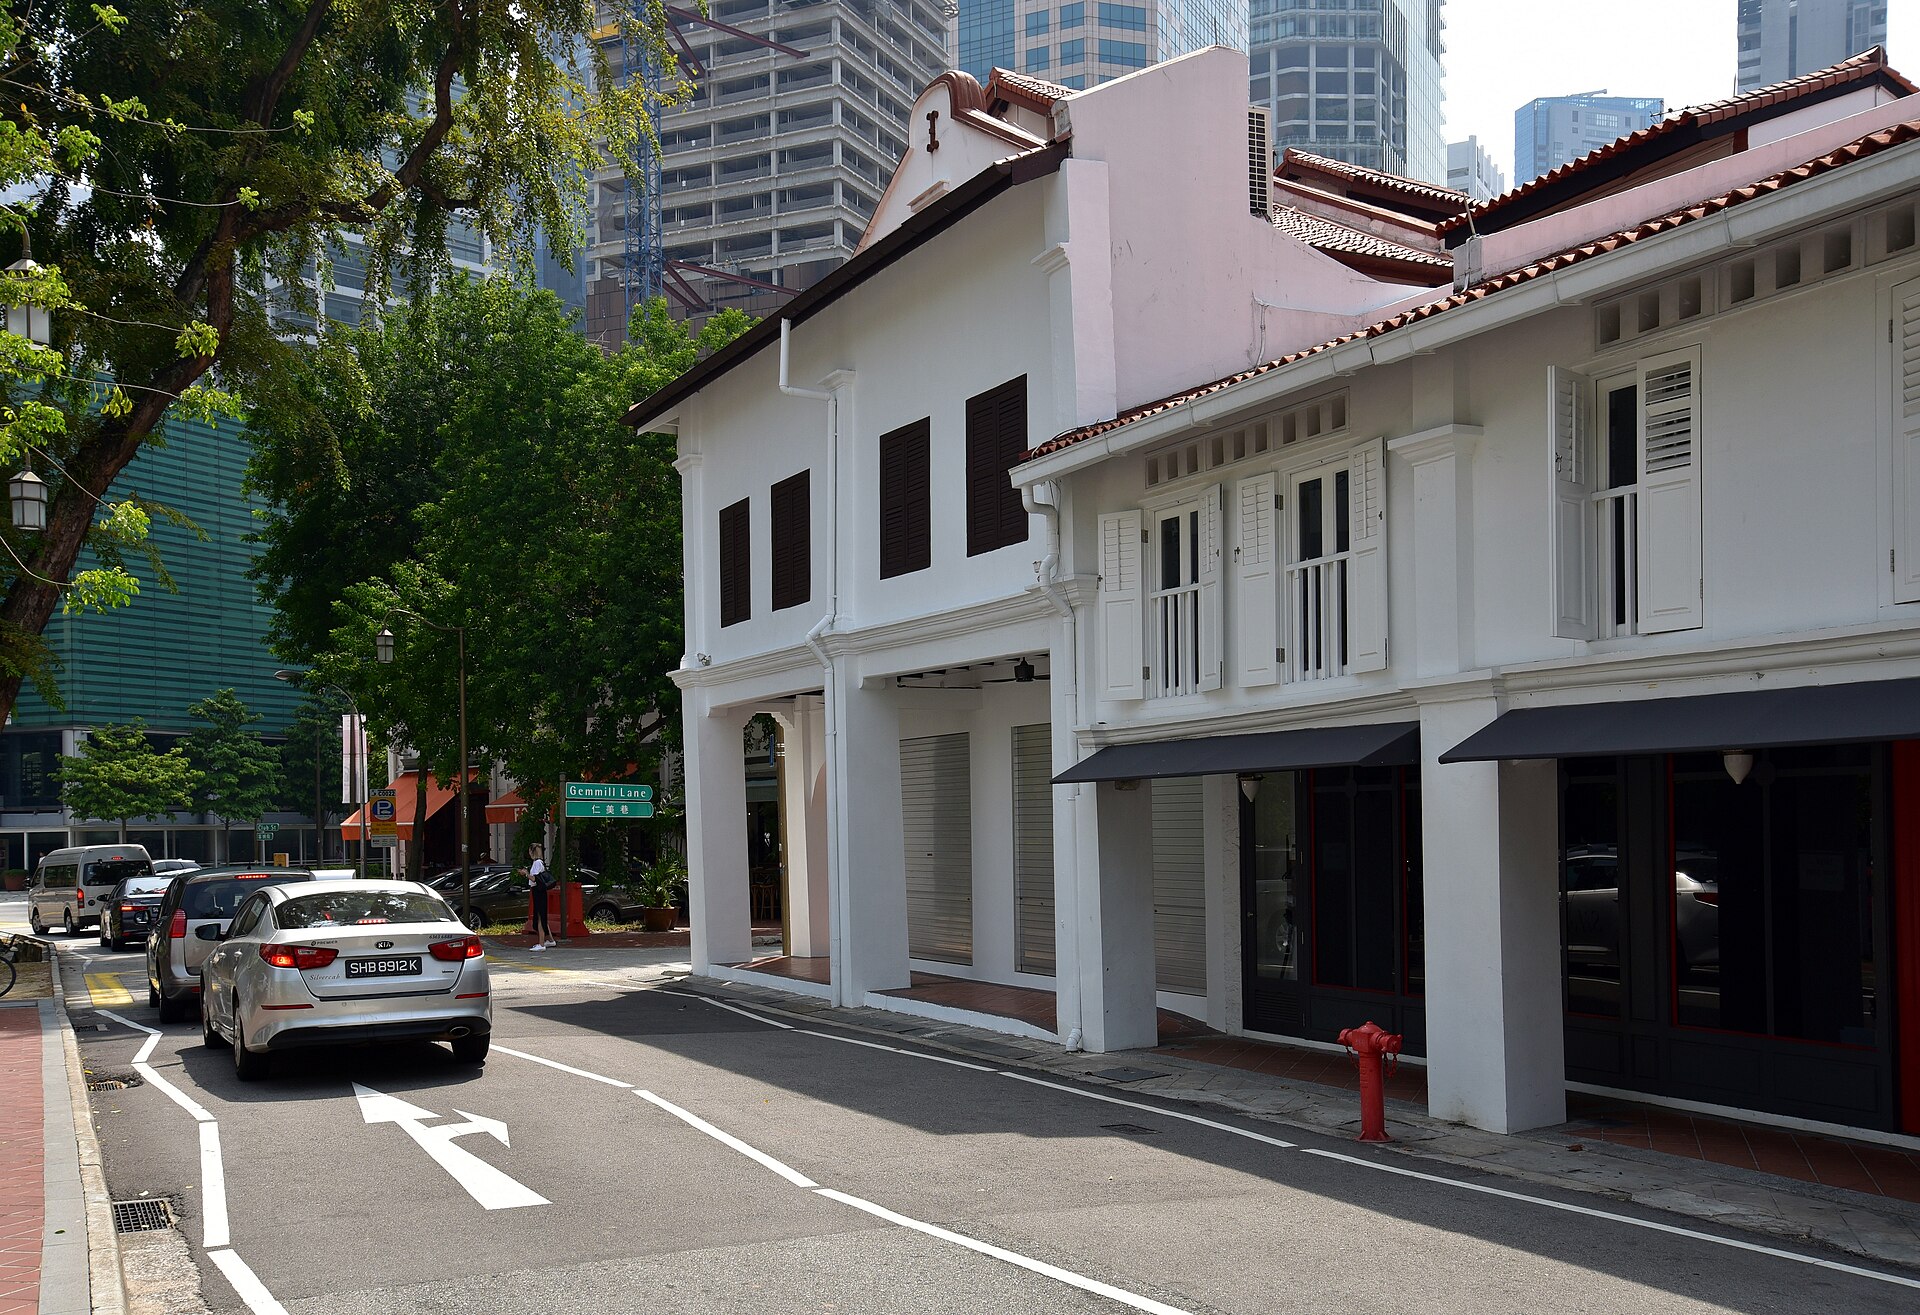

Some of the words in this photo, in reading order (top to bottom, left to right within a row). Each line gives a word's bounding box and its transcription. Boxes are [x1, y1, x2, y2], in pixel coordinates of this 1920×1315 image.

[569, 785, 616, 797] Gemmill
[620, 787, 646, 798] Lane
[378, 941, 391, 949] KIA
[309, 973, 341, 981] Silvercab
